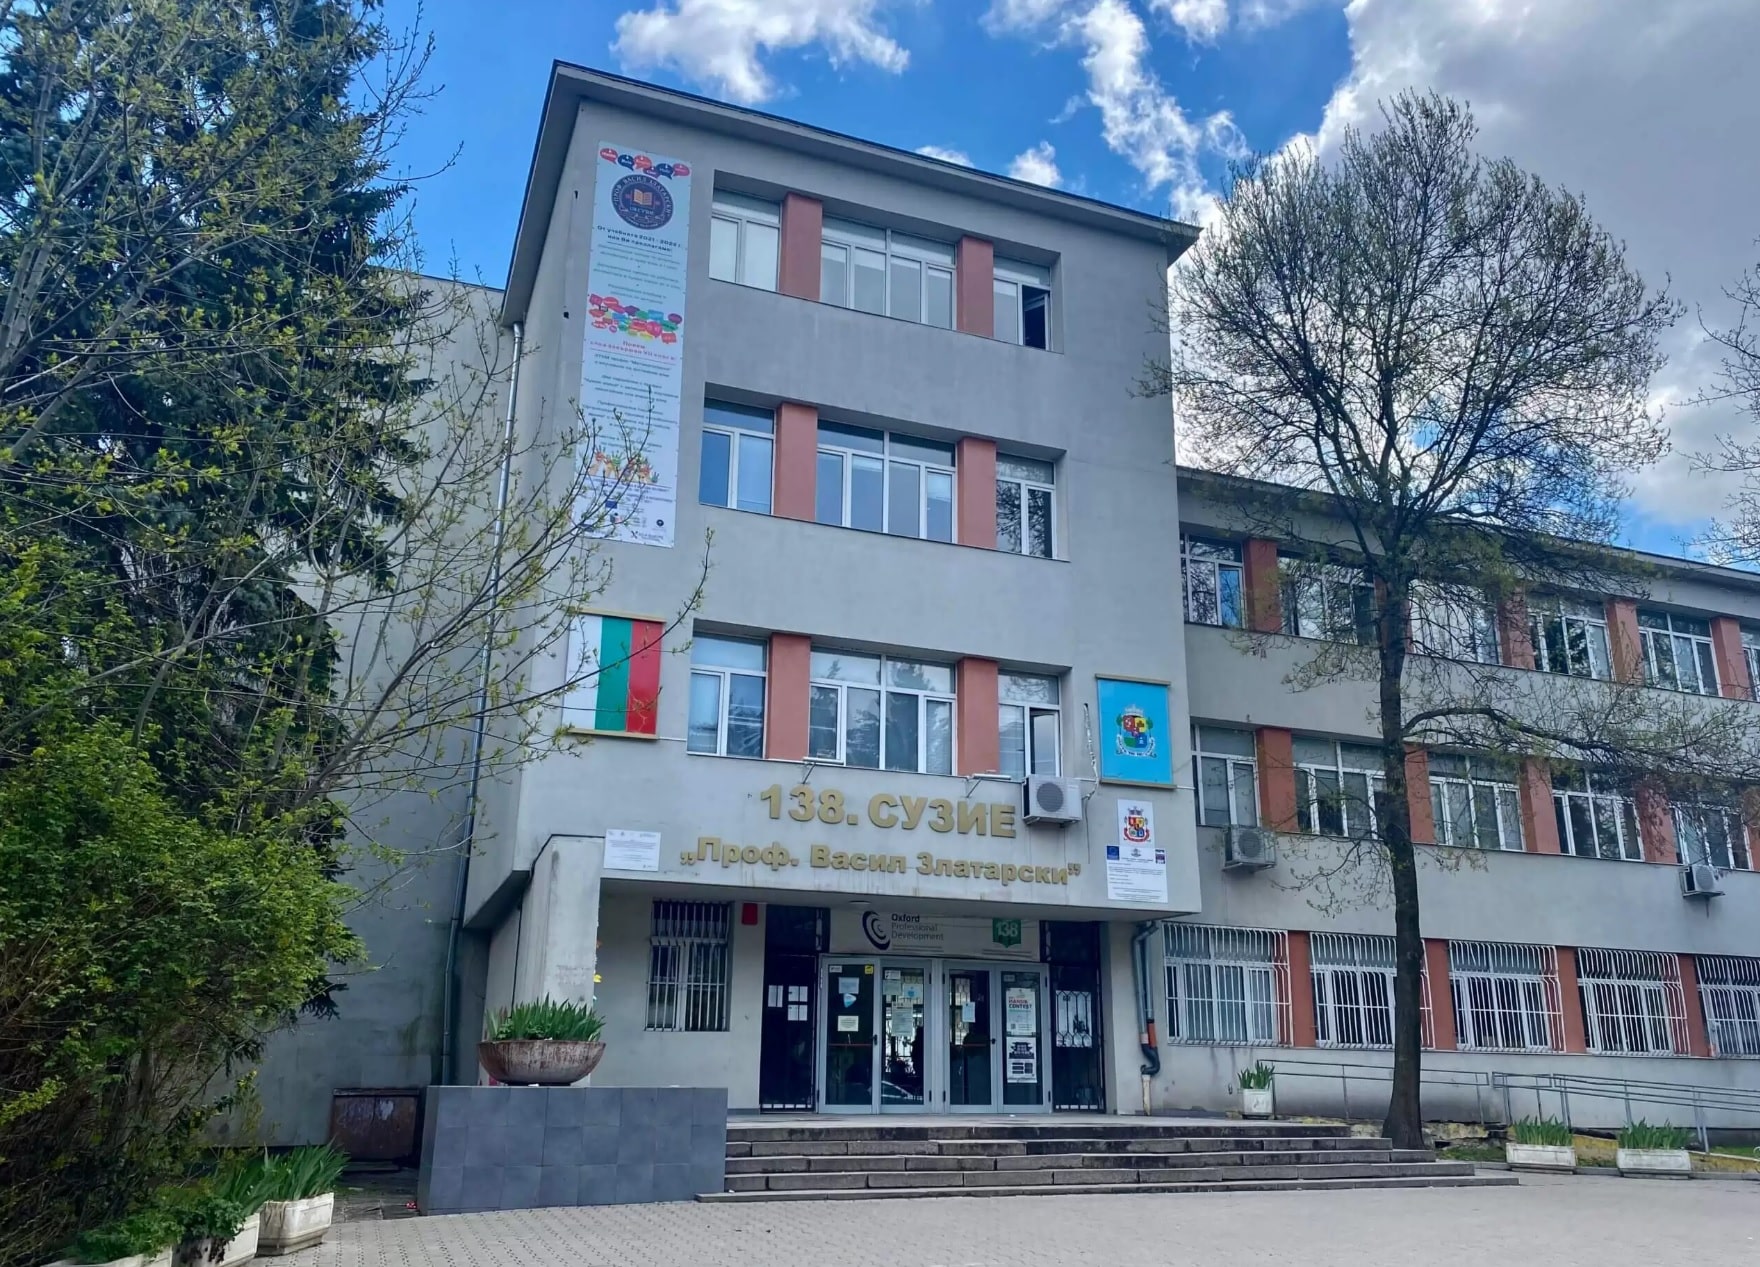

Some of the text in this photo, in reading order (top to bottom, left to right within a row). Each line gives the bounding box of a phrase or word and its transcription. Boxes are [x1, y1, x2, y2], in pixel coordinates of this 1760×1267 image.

[761, 783, 1017, 839] 138. СУЗИЕ
[680, 837, 799, 871] „Проф.
[810, 844, 907, 874] Васил
[891, 913, 920, 922] Oxford
[891, 923, 938, 931] Professional
[996, 921, 1018, 937] 138
[891, 931, 944, 941] Development
